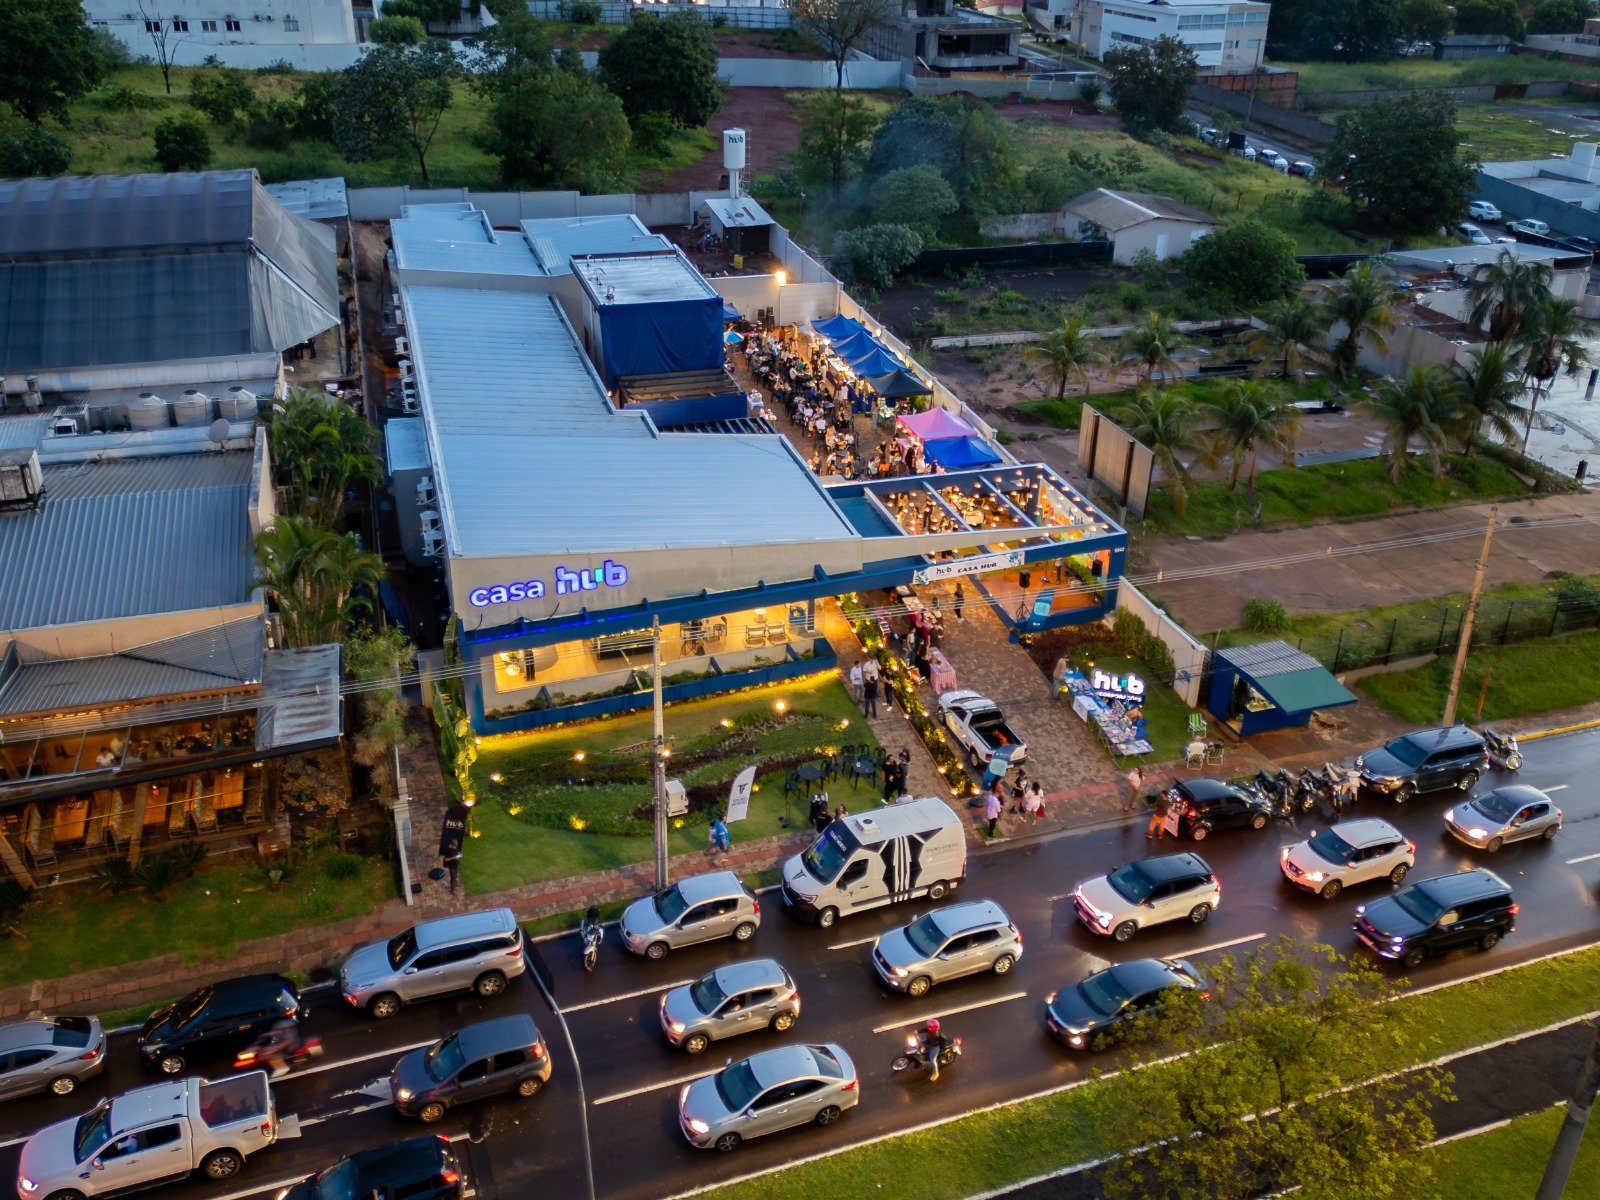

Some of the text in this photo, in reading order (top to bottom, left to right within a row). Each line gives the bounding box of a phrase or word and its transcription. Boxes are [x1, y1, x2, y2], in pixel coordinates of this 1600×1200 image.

[729, 135, 744, 143] hub
[980, 562, 997, 570] HUB
[936, 566, 952, 575] hub
[470, 560, 628, 607] casa hub
[1094, 670, 1144, 695] hub
[446, 820, 464, 828] hub
